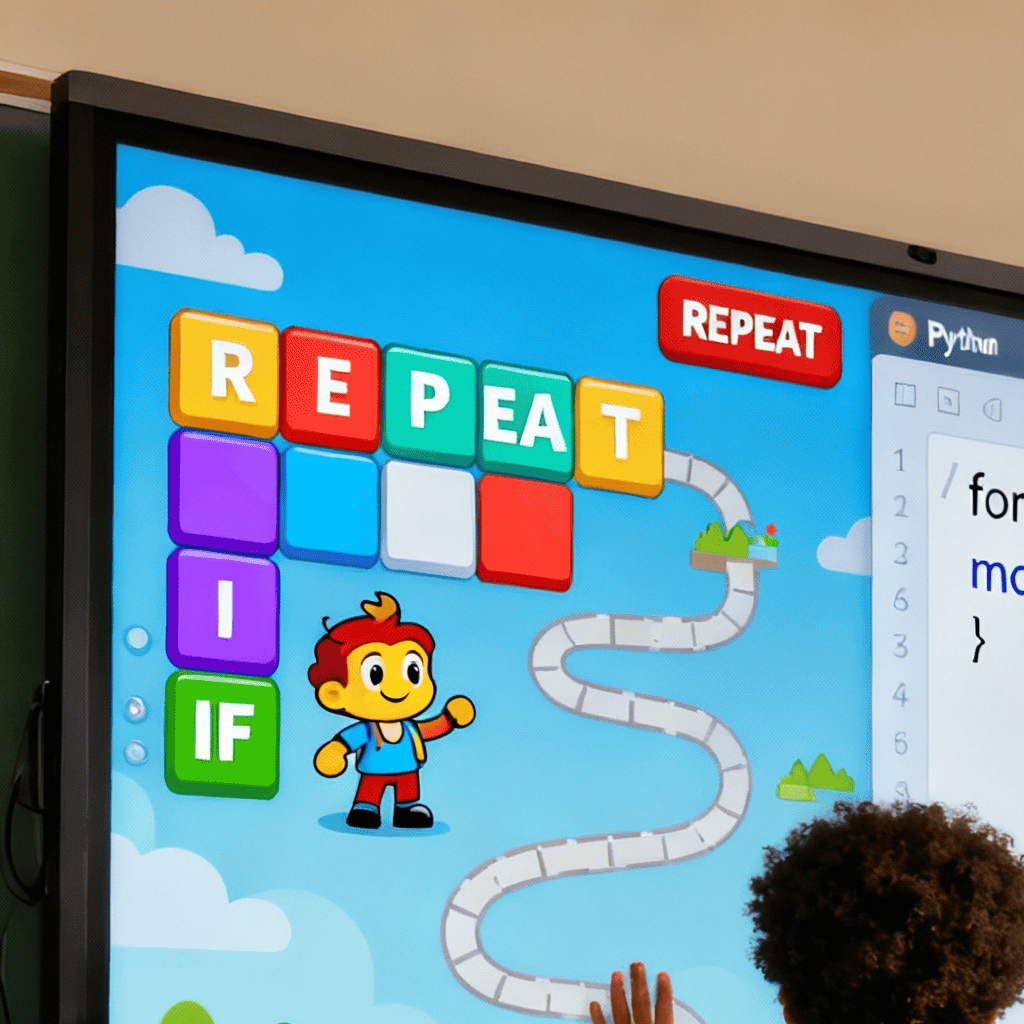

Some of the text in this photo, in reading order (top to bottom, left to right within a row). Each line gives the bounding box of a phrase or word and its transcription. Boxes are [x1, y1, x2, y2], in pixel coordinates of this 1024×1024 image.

[682, 299, 823, 359] REPEAT
[893, 448, 904, 472] 1
[893, 494, 909, 518] 2
[893, 587, 909, 612] 6
[892, 633, 908, 658] 3
[972, 616, 986, 663] }
[892, 682, 908, 707] 4
[195, 700, 255, 761] IF
[895, 731, 908, 755] 6
